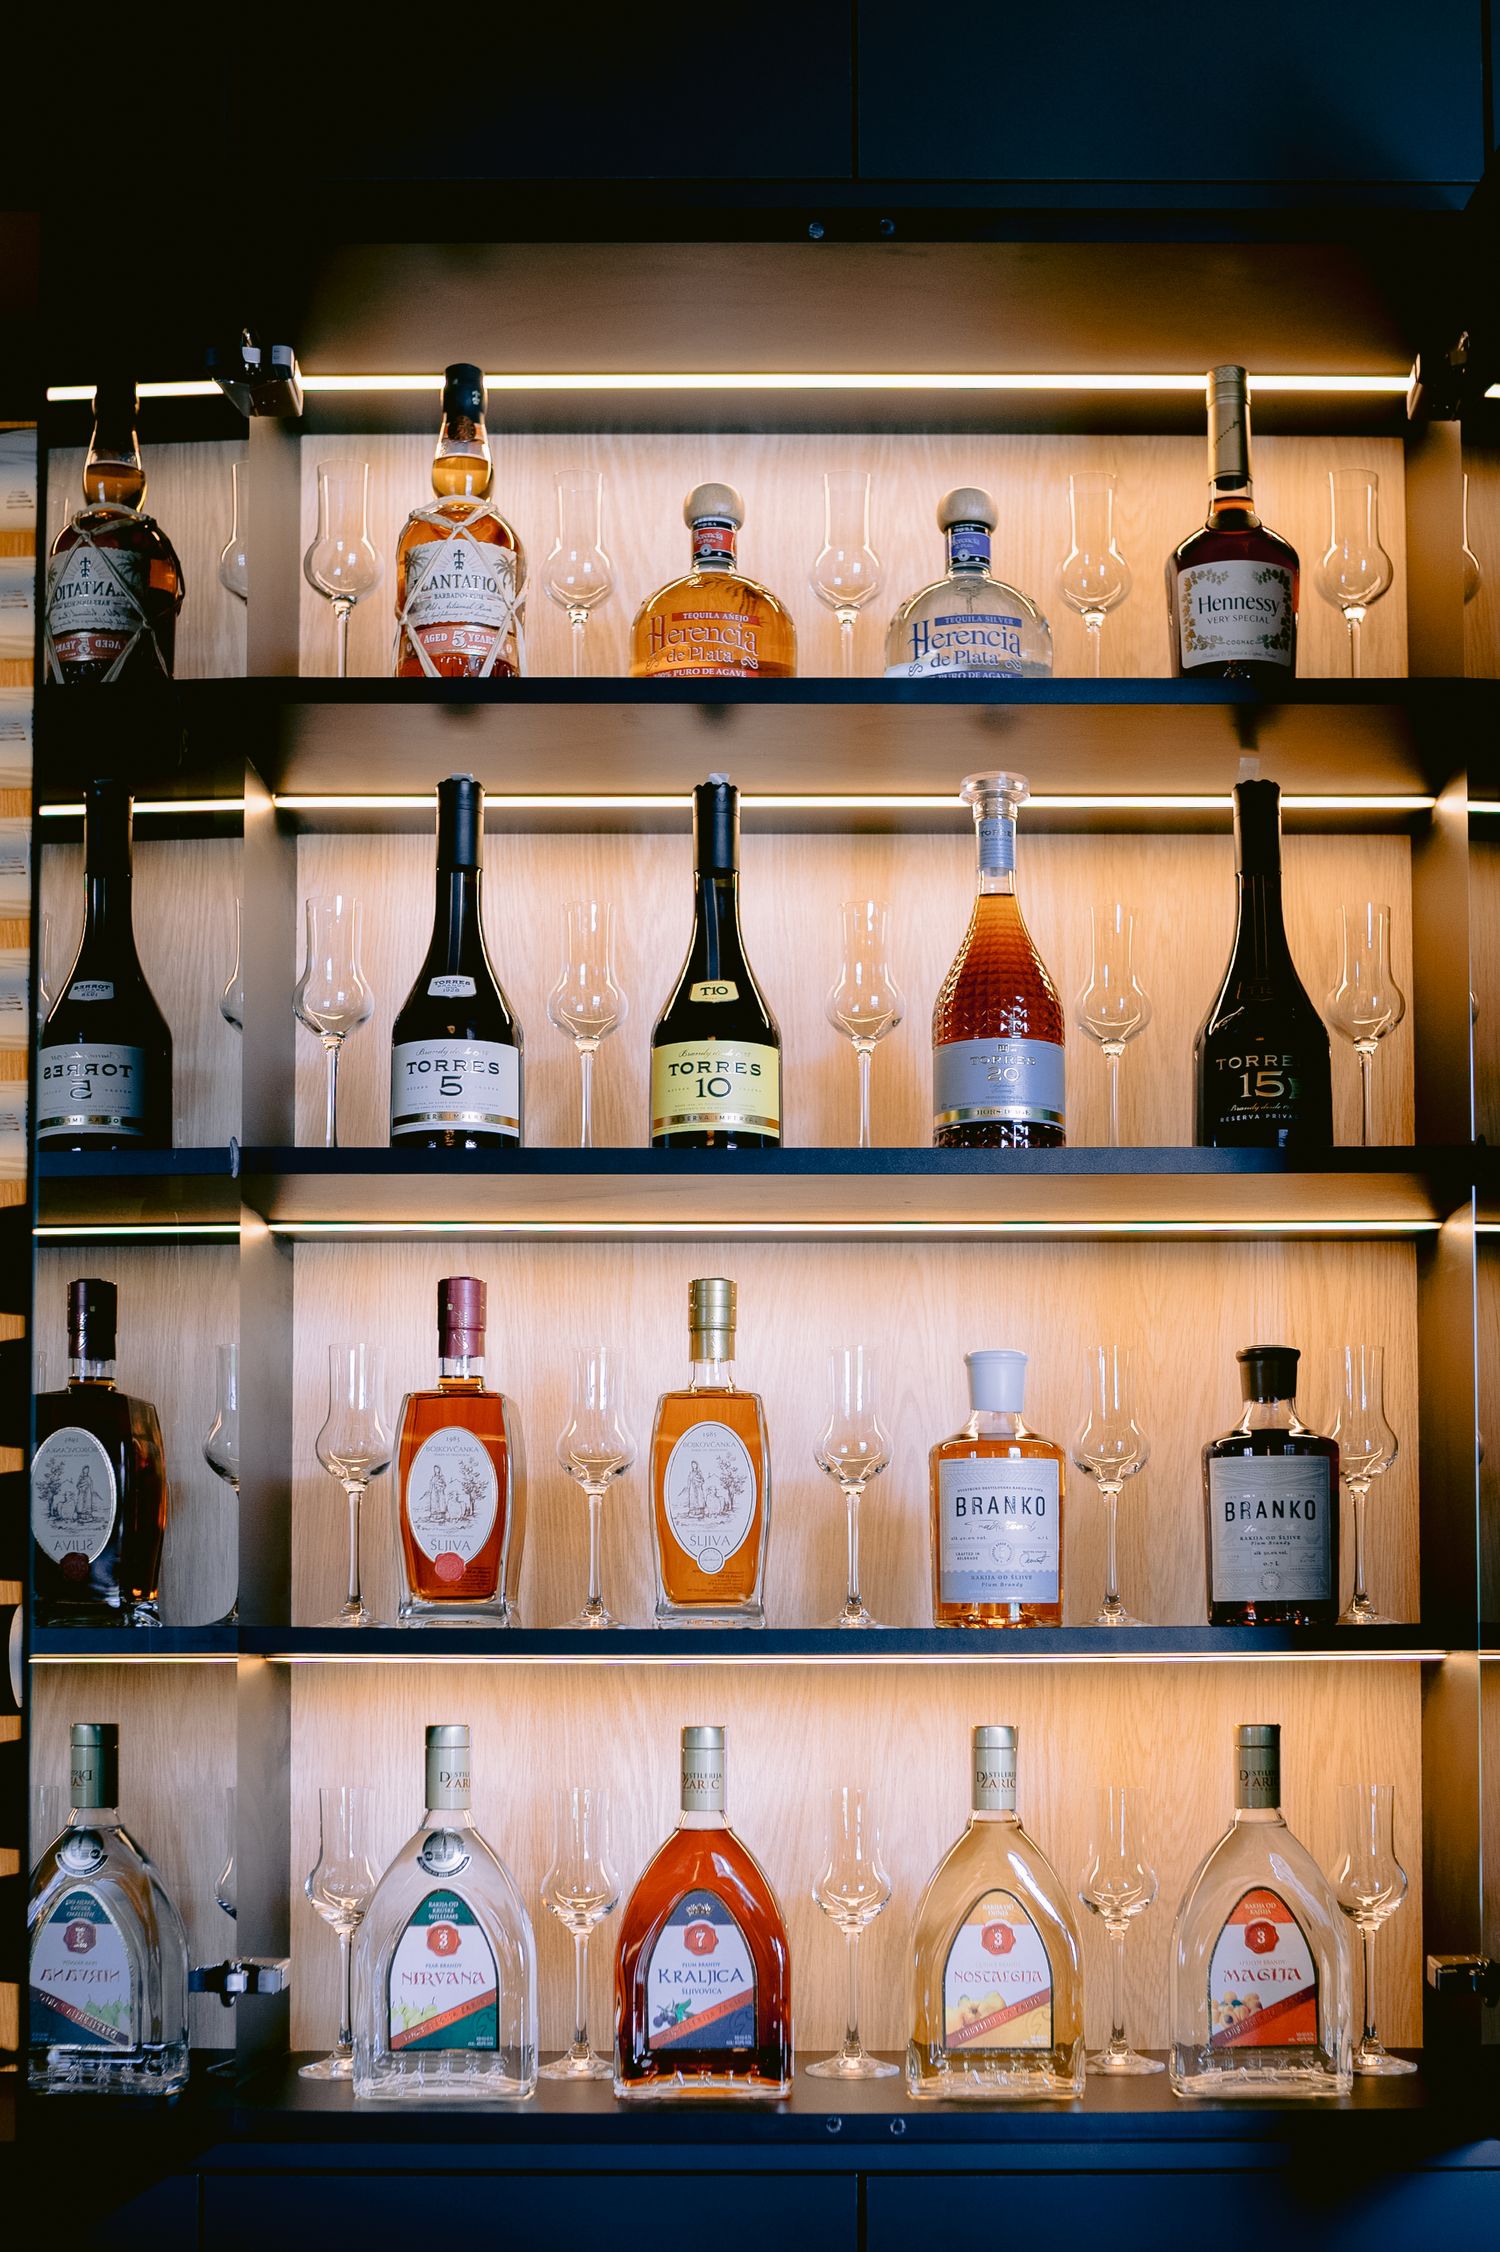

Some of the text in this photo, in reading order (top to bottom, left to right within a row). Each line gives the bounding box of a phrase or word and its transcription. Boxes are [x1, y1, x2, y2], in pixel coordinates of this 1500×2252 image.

[1198, 594, 1281, 618] Hennessy
[683, 612, 720, 620] TEQUILA
[945, 615, 1015, 625] TEQUILA SILVER
[1207, 614, 1272, 625] VERY SPECIAL
[424, 633, 448, 645] AGED
[451, 630, 468, 648] 5
[646, 615, 759, 656] Herencia
[908, 620, 1022, 660] Herencia
[667, 646, 735, 663] de Plata
[930, 650, 999, 668] de Plata
[702, 668, 715, 676] DE
[716, 668, 748, 678] AGAVE
[700, 986, 729, 996] T10
[406, 1059, 500, 1075] TORRES
[668, 1061, 762, 1076] TORRES
[970, 1055, 1036, 1066] TORRES
[1215, 1054, 1294, 1071] TORRE
[987, 1066, 1020, 1082] 20
[439, 1075, 463, 1096] 5
[695, 1077, 732, 1098] 10
[1239, 1070, 1285, 1098] 15
[1220, 1113, 1260, 1123] RESERVA
[956, 1495, 1046, 1517] BRANKO
[1225, 1499, 1316, 1521] BRANKO
[430, 1537, 471, 1551] ŠLJIVA
[689, 1534, 731, 1547] ŠLJIVA
[428, 1913, 459, 1921] WILLIAMS
[695, 1932, 706, 1948] 7
[1257, 1930, 1266, 1945] 3
[401, 1971, 486, 1987] NIRVANA
[658, 1968, 745, 1987] KRALJICA
[954, 1969, 1043, 1984] NOSTALGIJA
[1223, 1967, 1302, 1983] MAGIJA
